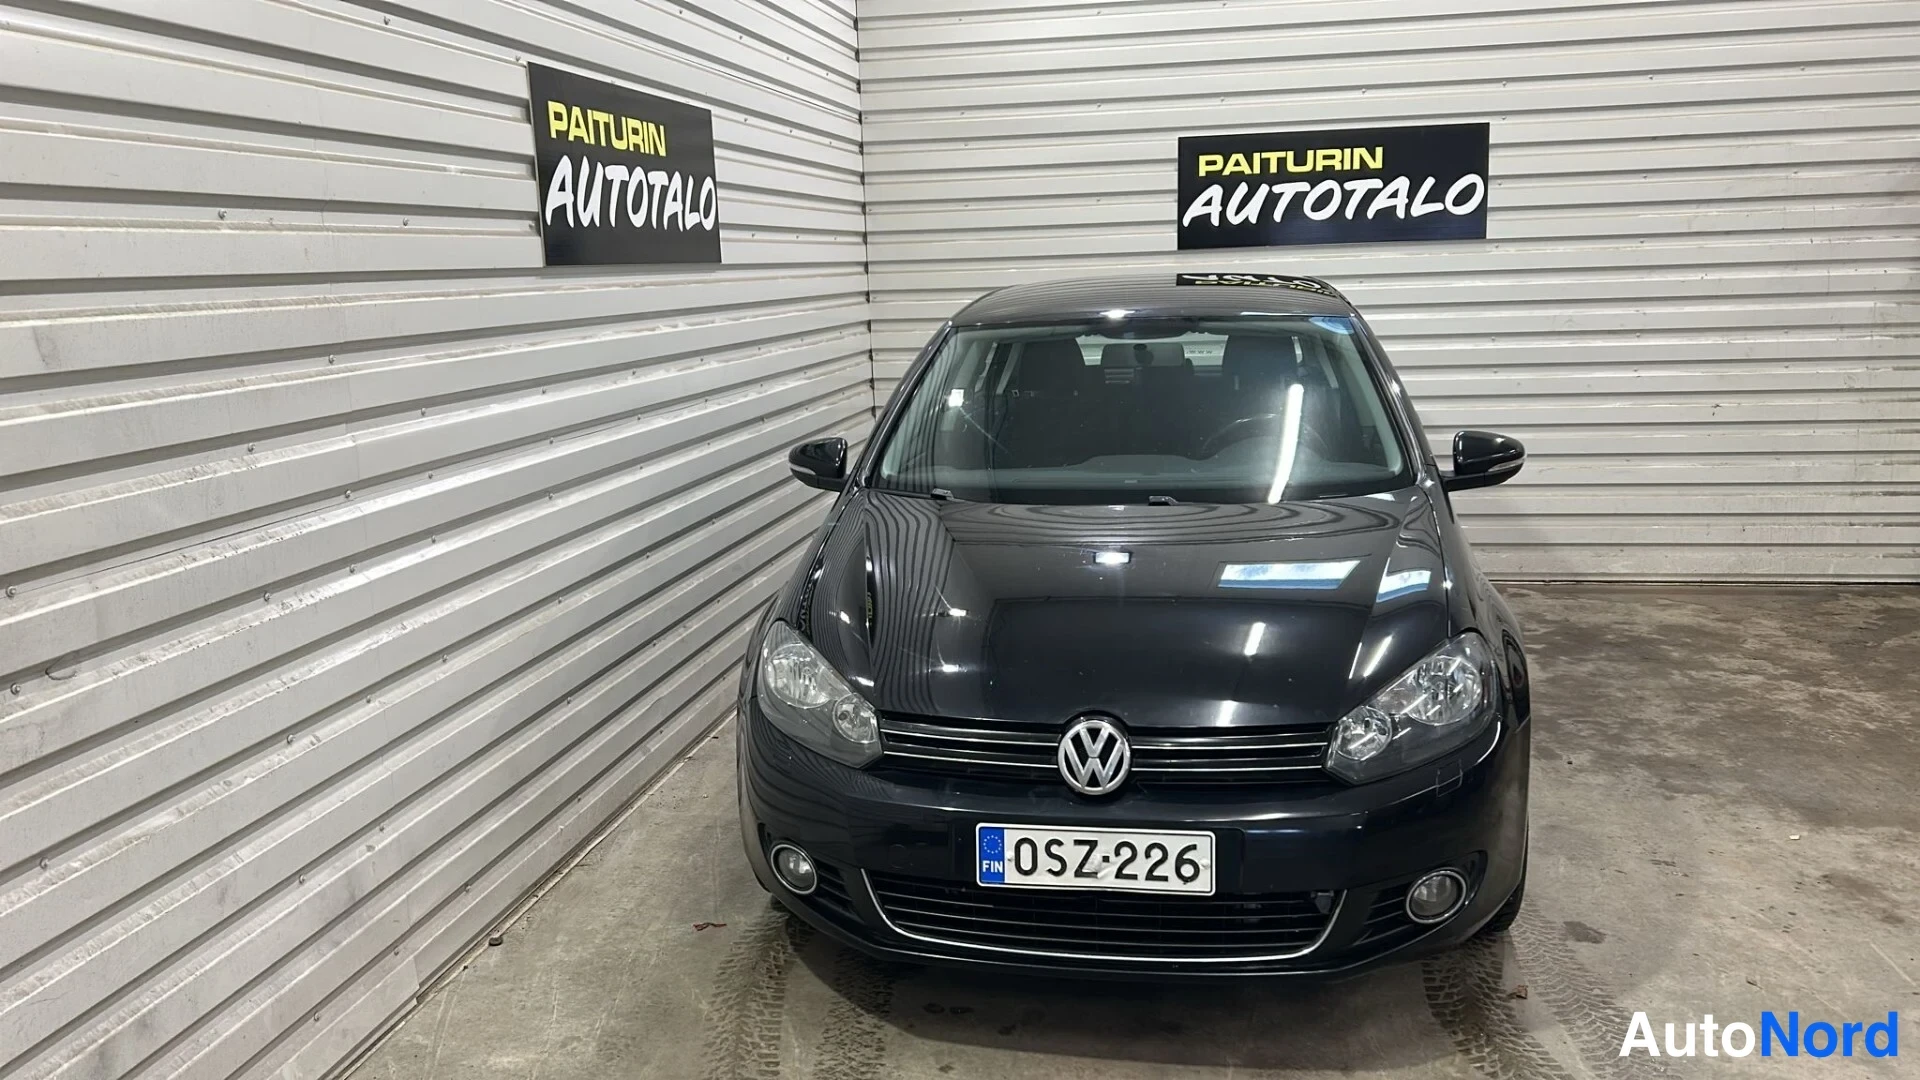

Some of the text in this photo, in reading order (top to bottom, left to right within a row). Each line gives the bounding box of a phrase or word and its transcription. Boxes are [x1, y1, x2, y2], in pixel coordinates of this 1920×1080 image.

[548, 101, 666, 157] PAITURIN
[1198, 146, 1383, 177] PAITURIN
[545, 155, 716, 232] AUTOTALO
[1182, 173, 1485, 227] AUTOTALO
[982, 837, 1201, 885] FIN OSZ-226
